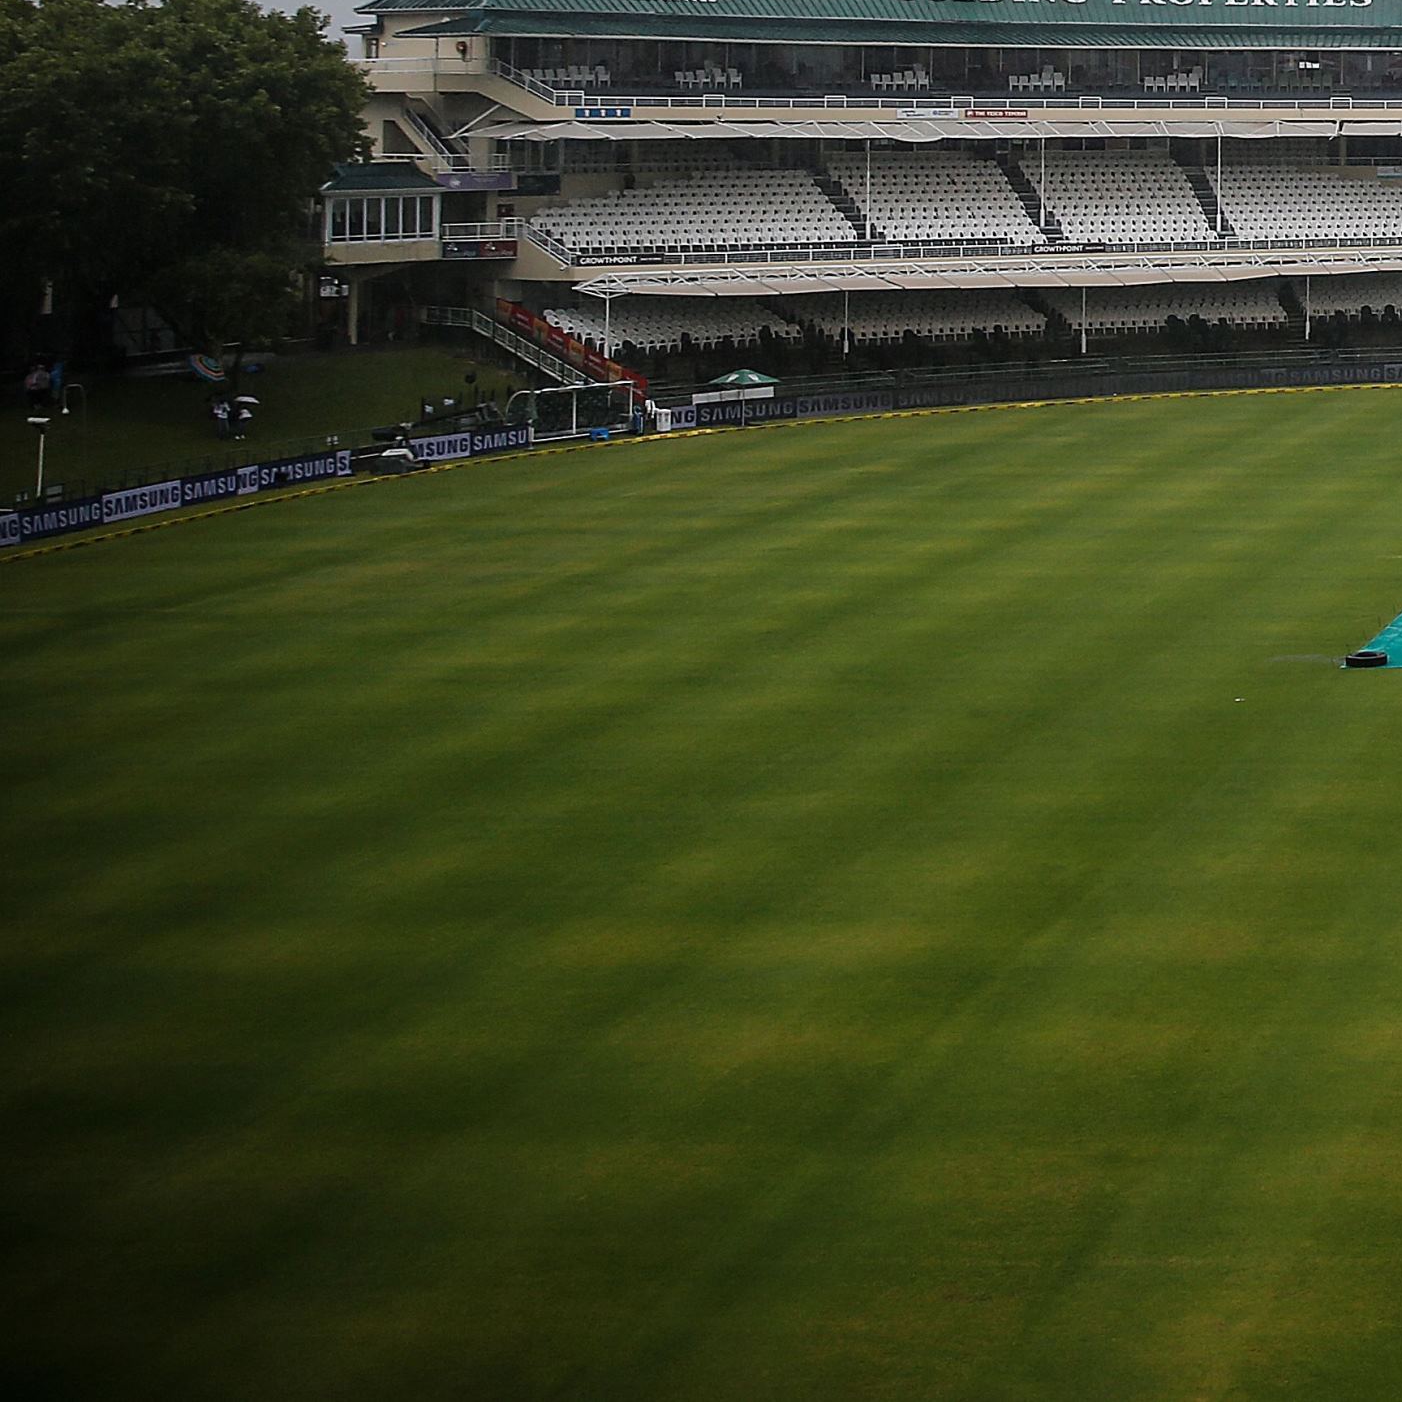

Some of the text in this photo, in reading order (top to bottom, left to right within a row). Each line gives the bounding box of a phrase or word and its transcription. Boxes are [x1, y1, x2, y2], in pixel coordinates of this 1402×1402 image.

[701, 402, 793, 422] SAMSUNG
[799, 395, 891, 414] SAMSUNG
[473, 429, 526, 450] SAMSU
[184, 469, 258, 500] SAMSUNG
[104, 486, 180, 516] SAMSUNG
[23, 503, 101, 535] SAMSUNG
